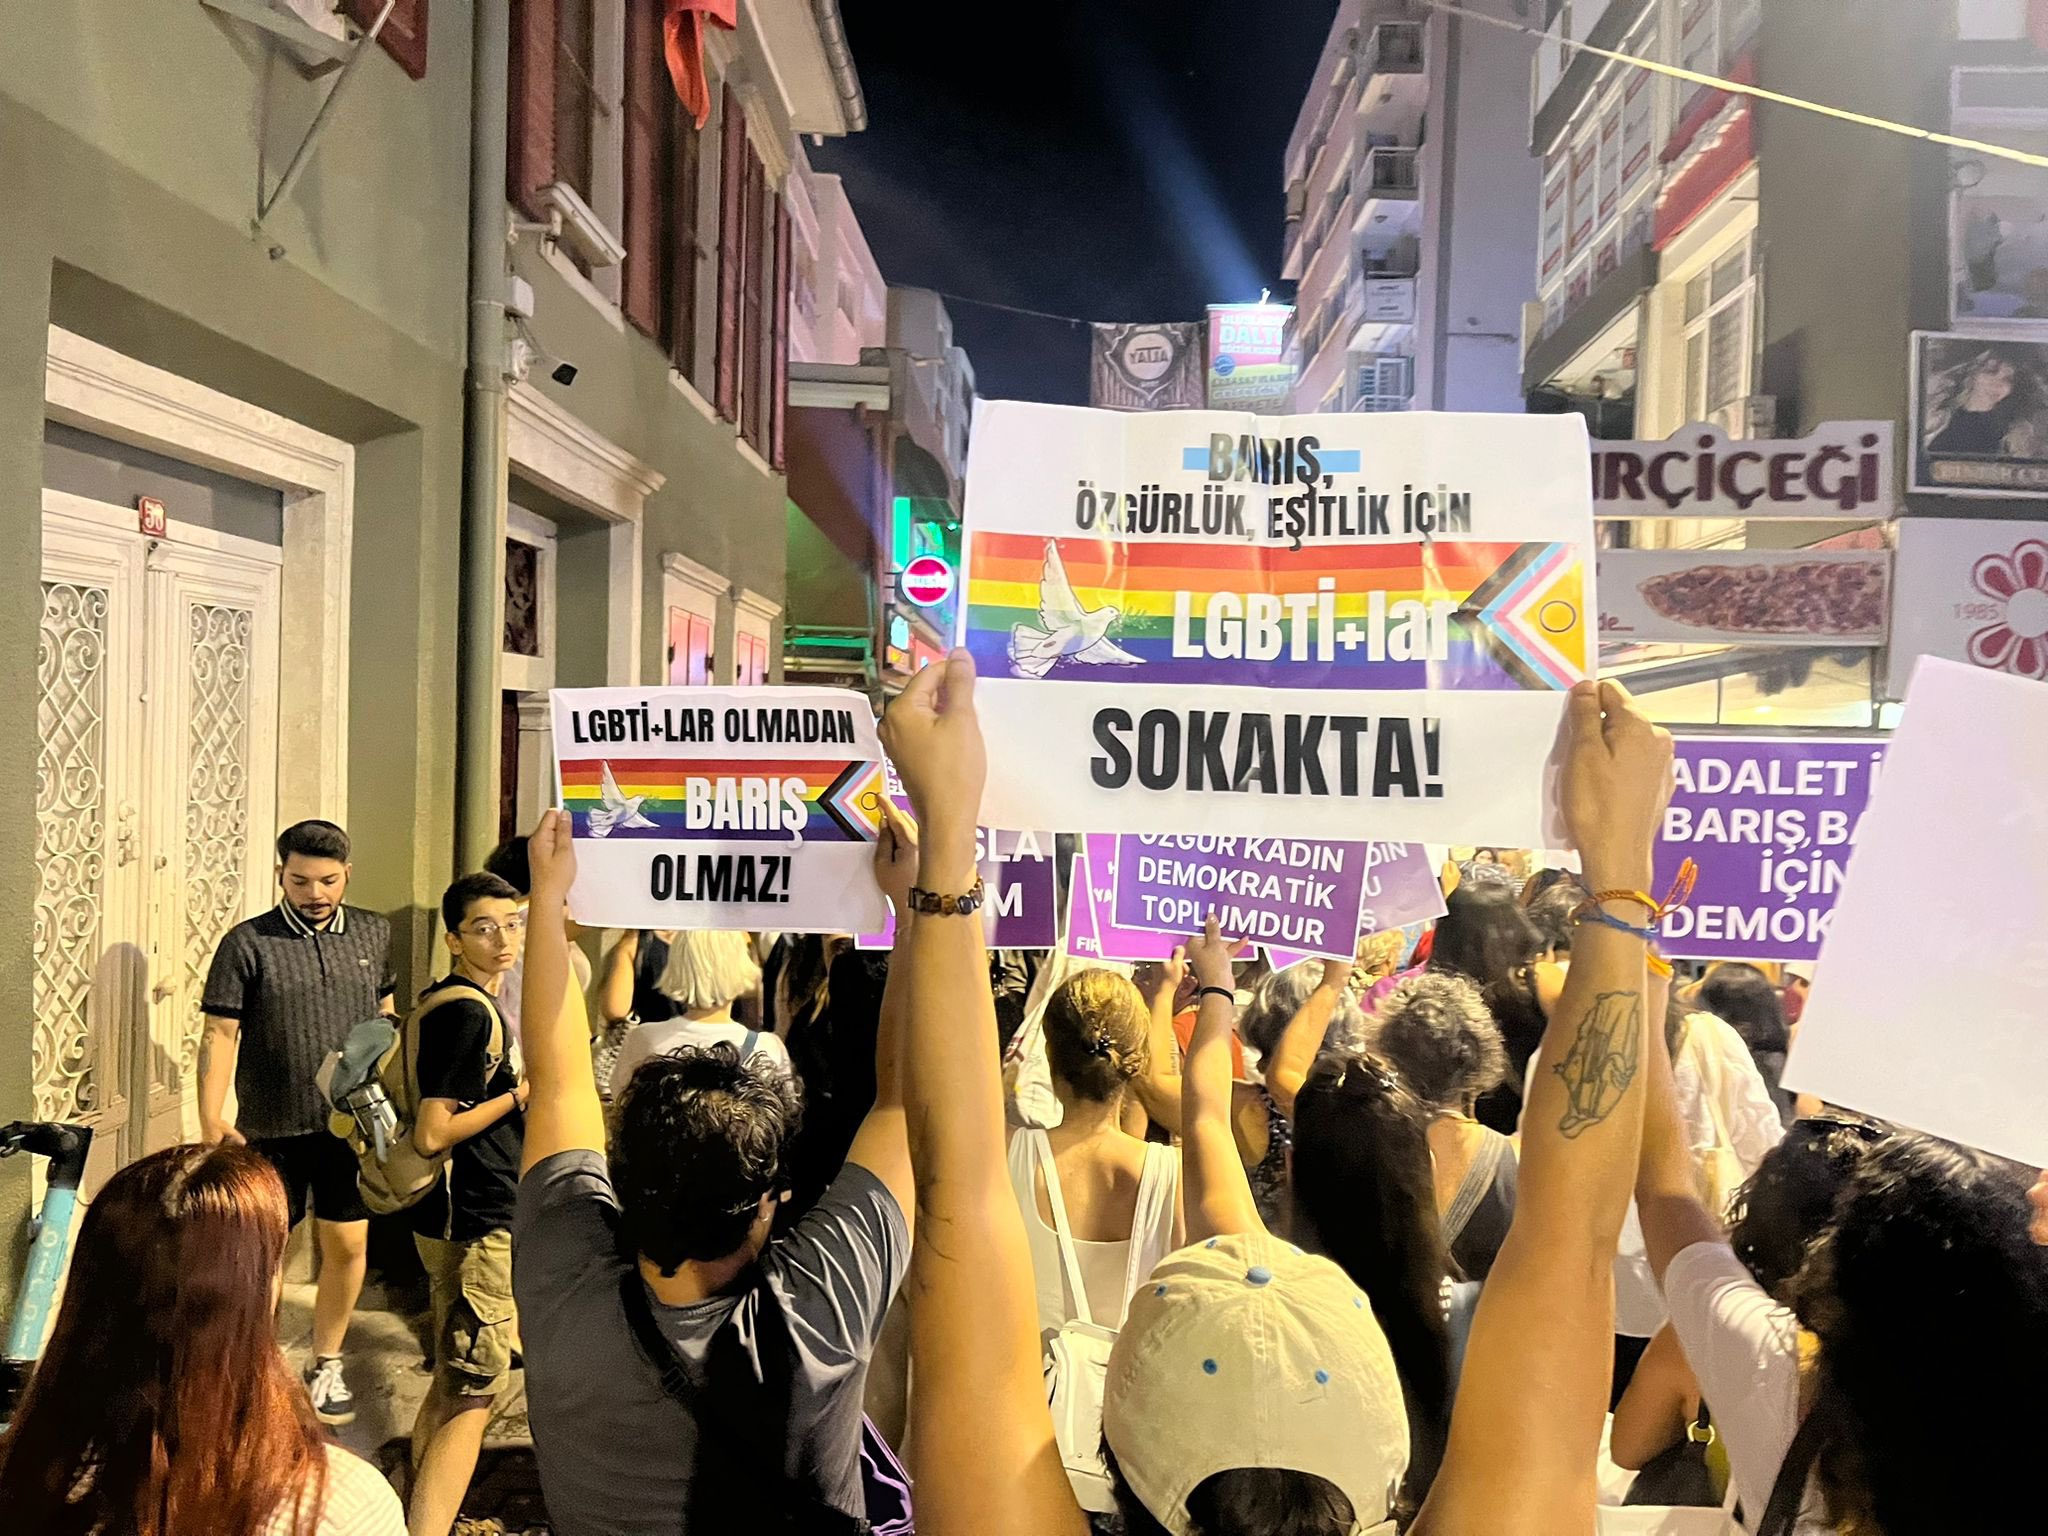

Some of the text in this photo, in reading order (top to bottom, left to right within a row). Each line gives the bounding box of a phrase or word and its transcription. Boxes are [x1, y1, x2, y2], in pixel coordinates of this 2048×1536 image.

[1208, 433, 1334, 499] BARIŞ,
[1075, 480, 1256, 541] ÖZGÜRLÜK,
[1403, 484, 1472, 546] İÇİN
[1172, 577, 1459, 662] LGBTİ+lar
[572, 701, 856, 744] LGBTİ+LAR OLMADAN
[1090, 708, 1445, 797] SOKAKTA!
[1671, 757, 1858, 796] ADALET
[685, 776, 808, 849] BARIŞ
[1662, 807, 1857, 855] BARIŞ, B
[650, 854, 791, 903] OLMAZ!
[1244, 836, 1345, 873] KADIN
[1759, 848, 1848, 903] İÇİN
[1138, 856, 1337, 910] DEMOKRATİK
[1141, 894, 1326, 945] TOPLUMDUR
